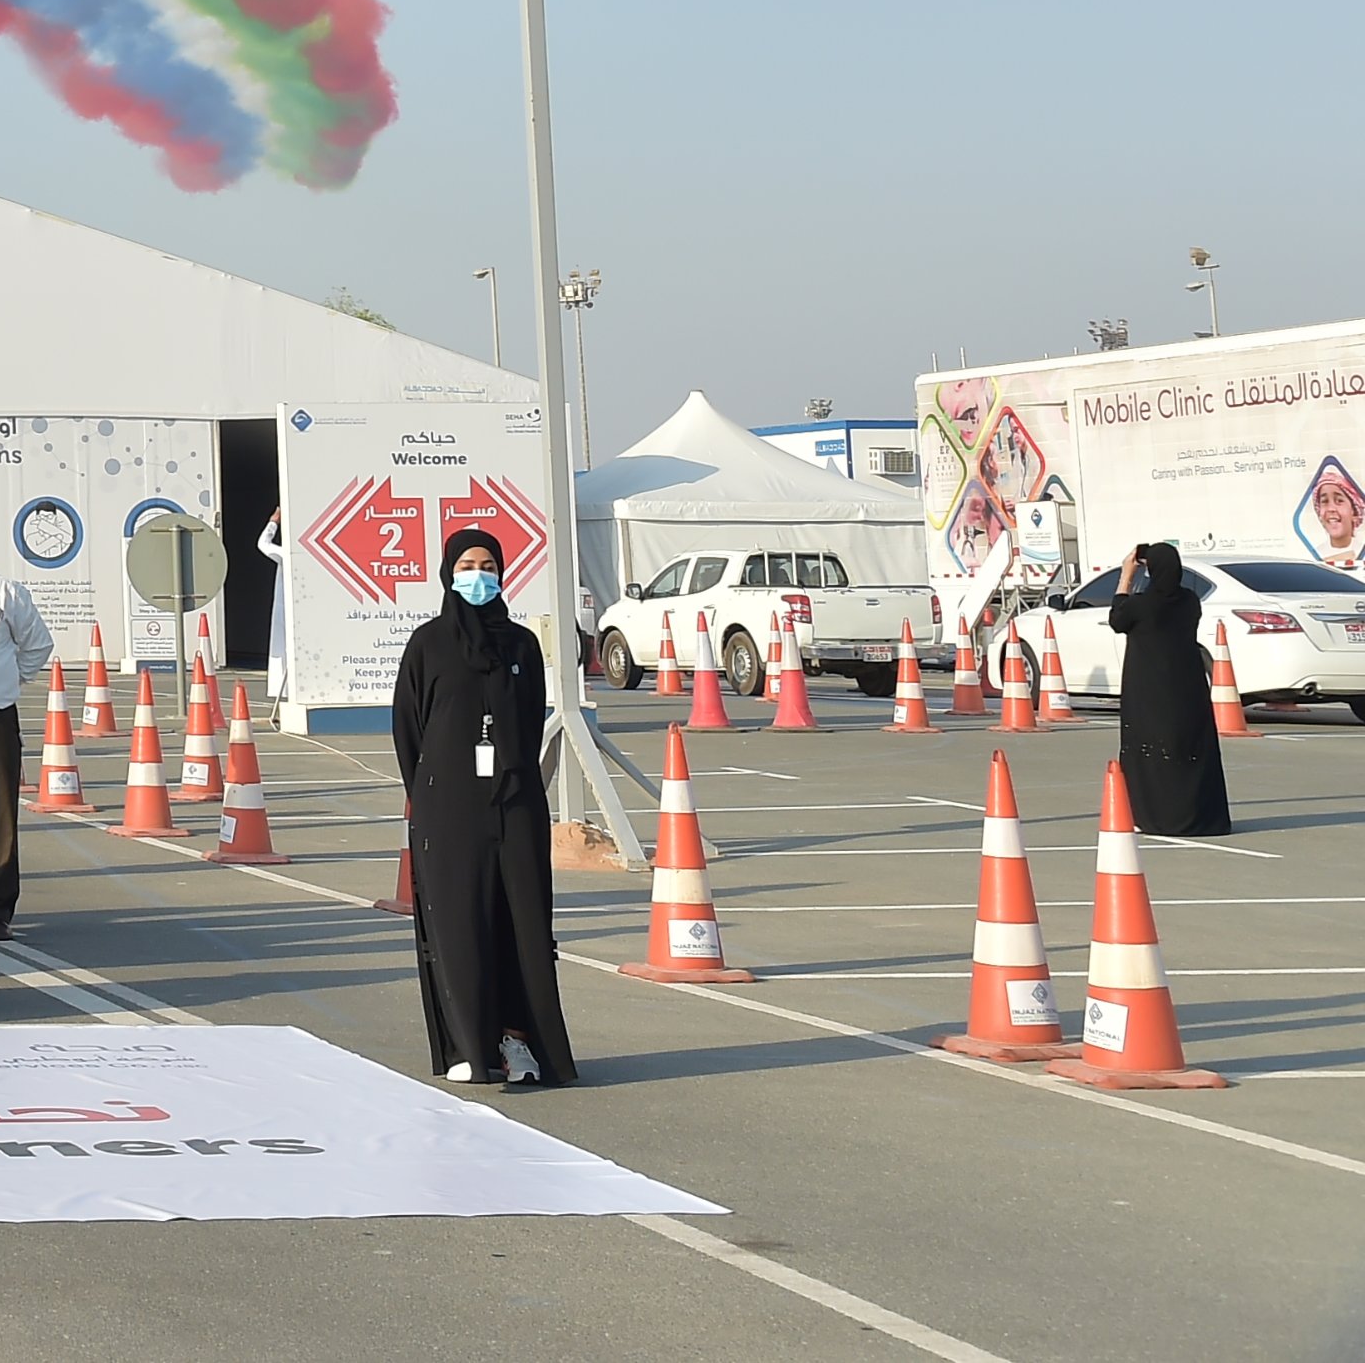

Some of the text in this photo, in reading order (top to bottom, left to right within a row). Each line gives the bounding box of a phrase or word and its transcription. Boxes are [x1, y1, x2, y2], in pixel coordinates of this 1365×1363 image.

[1224, 373, 1308, 407] المتنقلة
[1084, 386, 1215, 427] Mobile Clinic
[401, 431, 456, 447] حياكم
[391, 453, 468, 466] Welcome
[1151, 456, 1307, 481] Caring with Serving with Pride
[364, 506, 418, 521] مسار
[444, 506, 498, 521] مسار
[378, 522, 405, 558] 2
[370, 561, 421, 577] Track
[342, 656, 377, 664] Please
[355, 669, 382, 678] Keep
[349, 682, 395, 691] you reac
